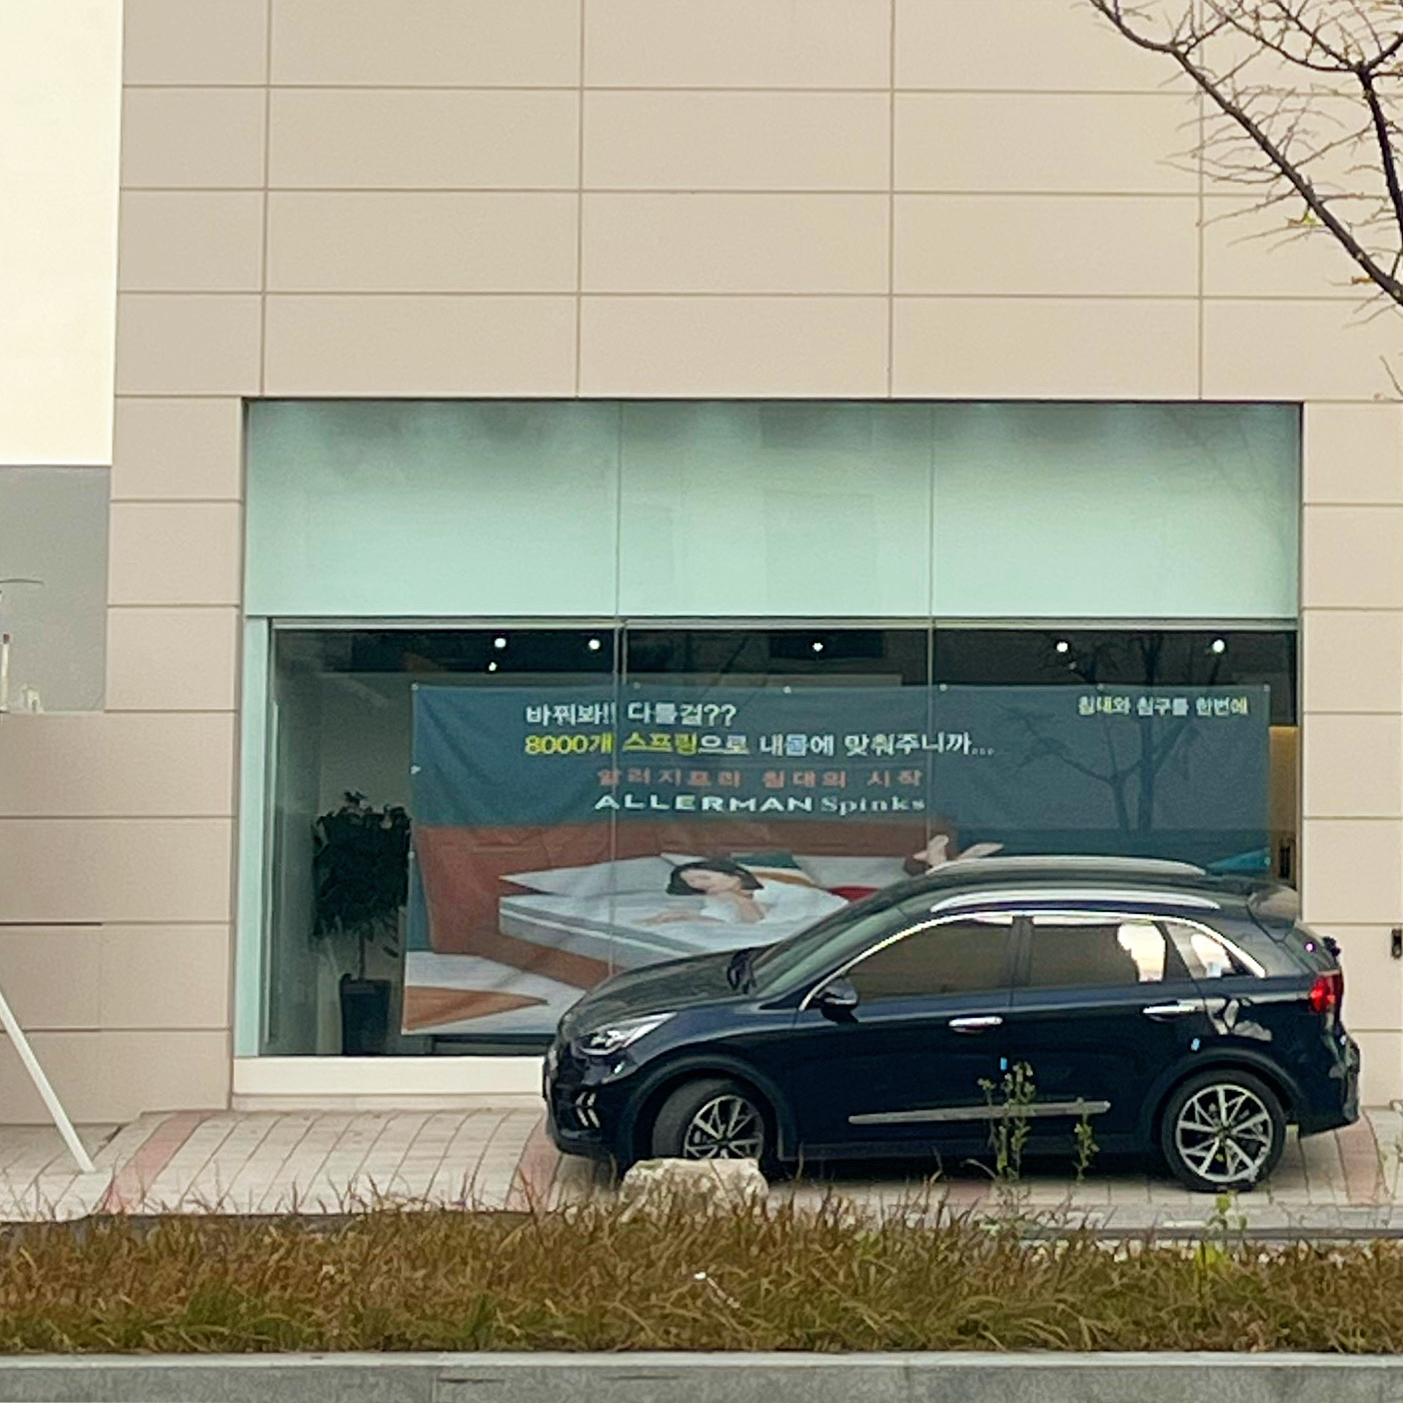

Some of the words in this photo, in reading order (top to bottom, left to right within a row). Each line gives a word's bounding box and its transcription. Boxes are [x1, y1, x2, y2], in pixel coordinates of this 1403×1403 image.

[525, 732, 614, 755] 8000개
[622, 732, 749, 756] 스프링으로
[759, 733, 834, 756] 내몸에
[866, 770, 922, 787] 시작
[594, 793, 813, 812] ALLERMAN
[820, 795, 926, 816] Spinks
